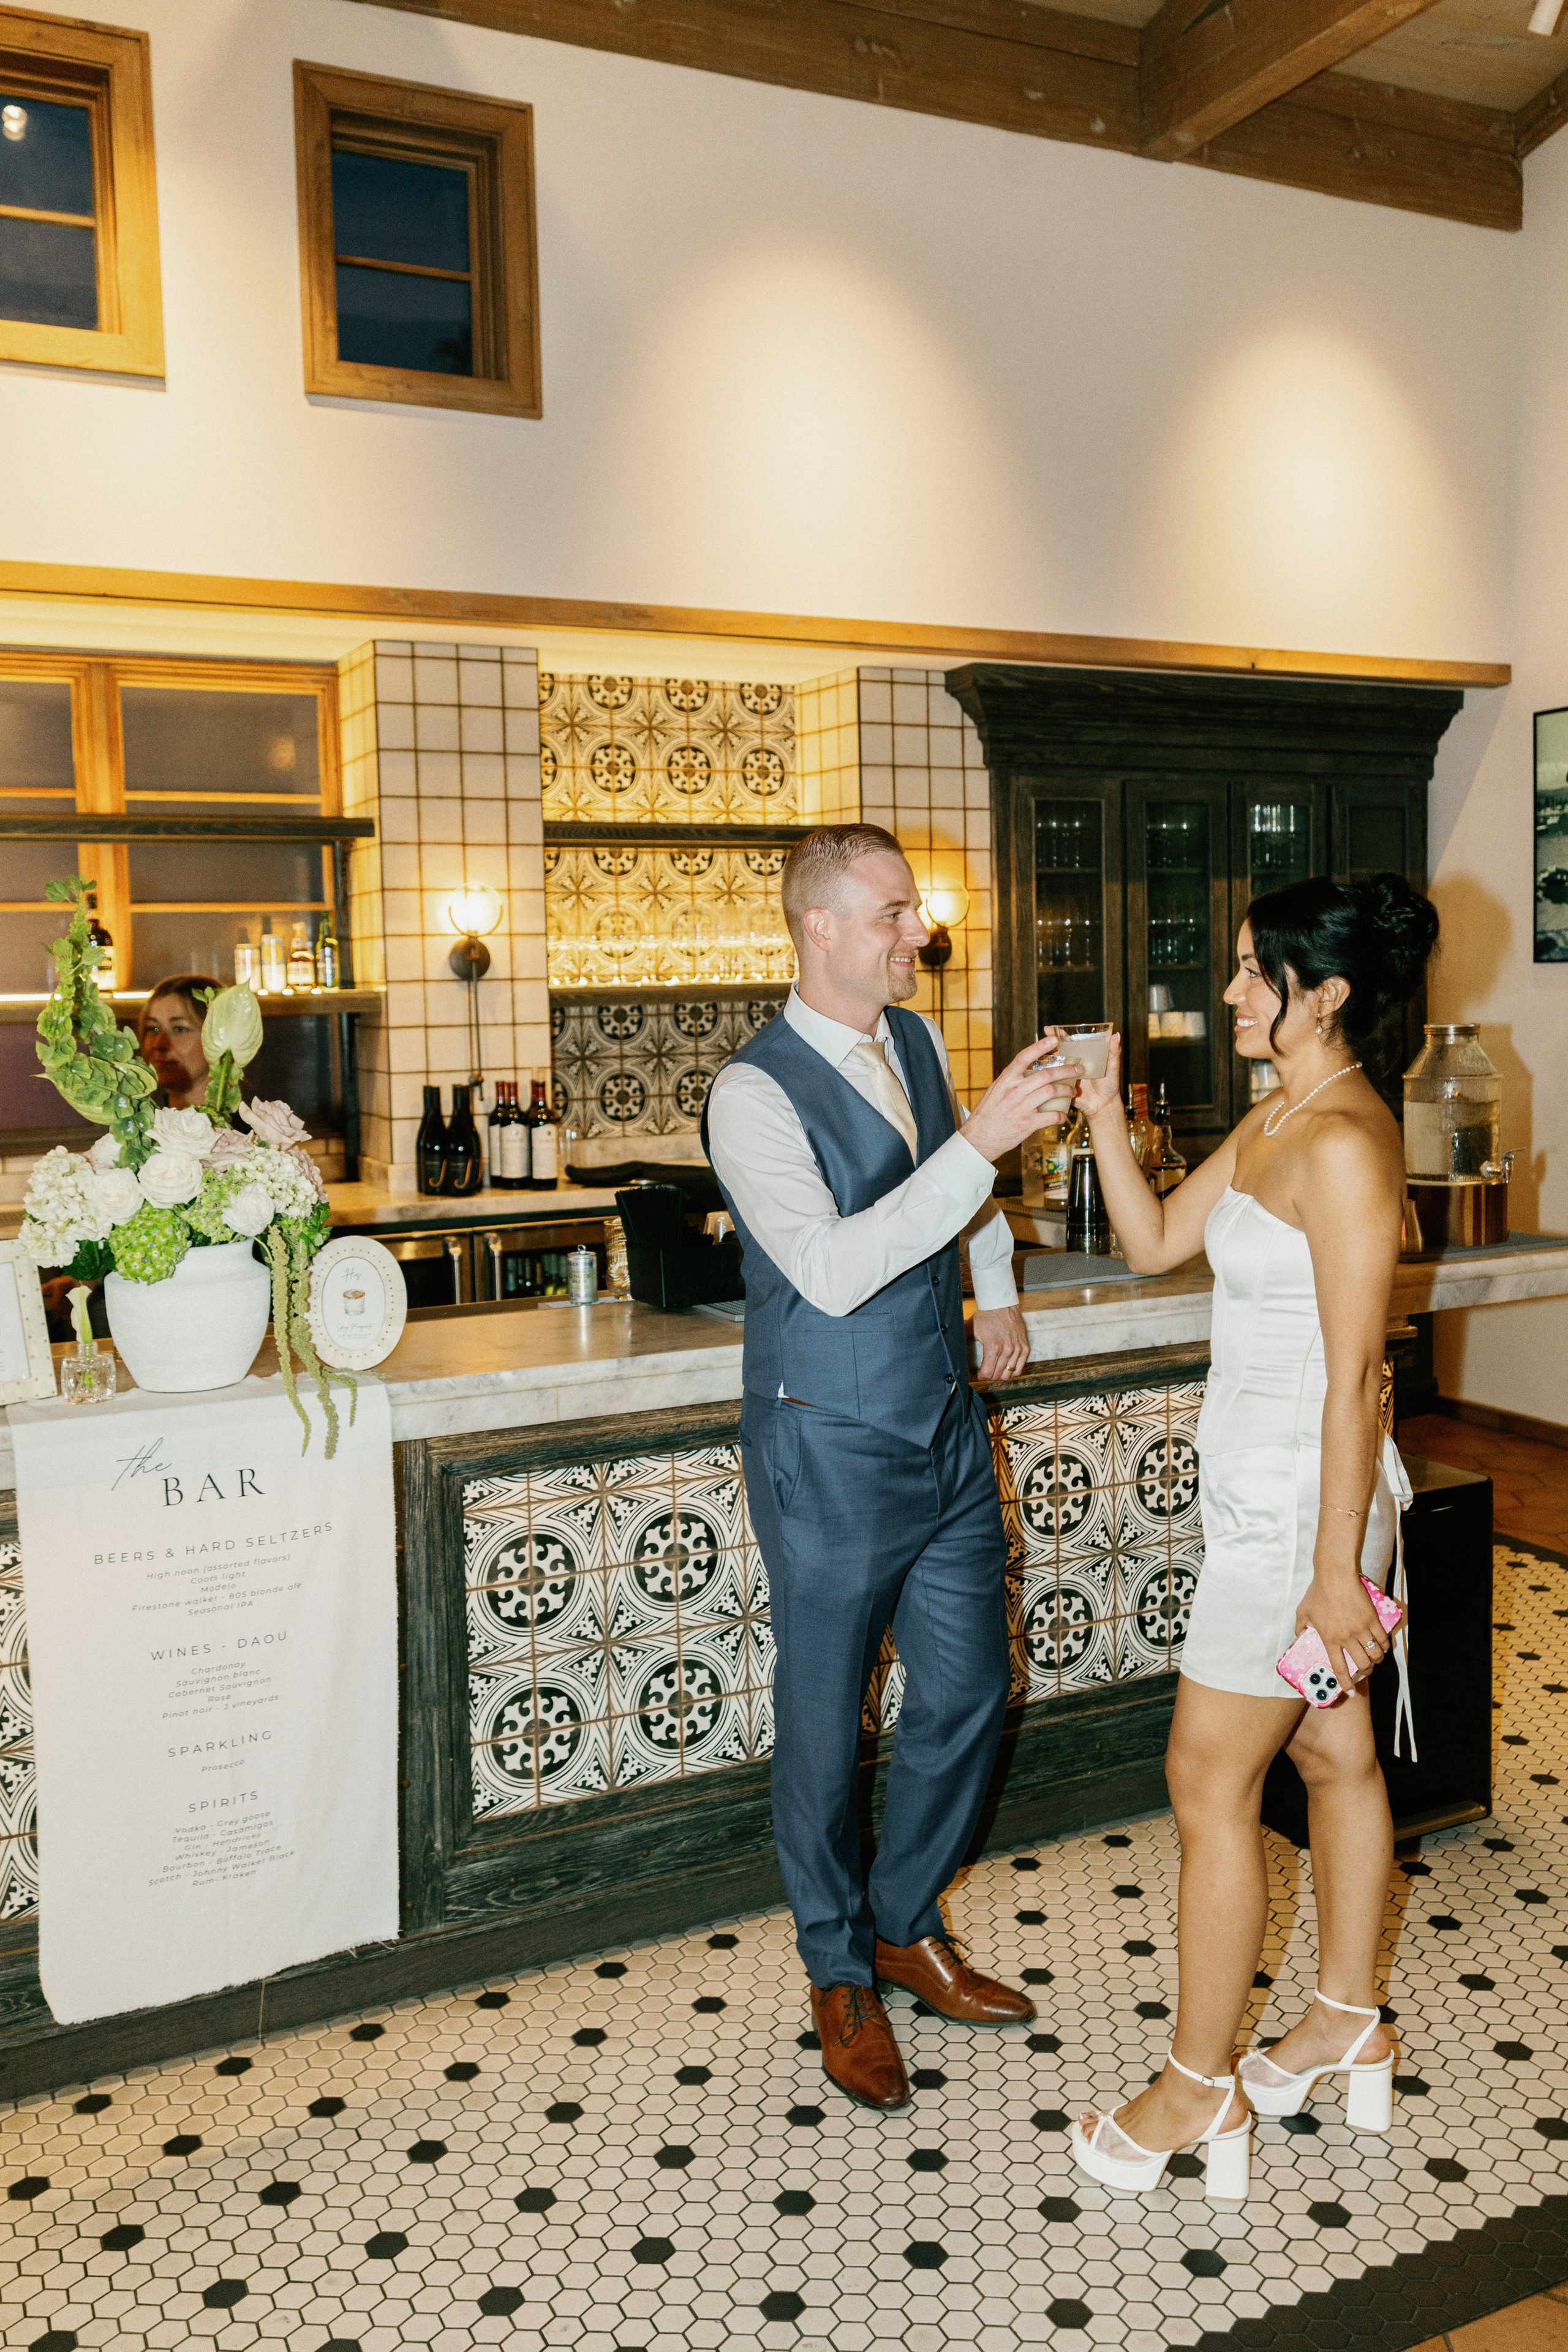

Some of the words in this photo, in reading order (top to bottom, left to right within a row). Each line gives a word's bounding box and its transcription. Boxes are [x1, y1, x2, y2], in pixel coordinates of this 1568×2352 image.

[111, 1437, 172, 1491] the
[161, 1468, 266, 1507] BAR
[94, 1550, 155, 1564] BEERS
[165, 1548, 175, 1558] &
[186, 1540, 236, 1555] HARD
[246, 1522, 333, 1547] SELTZERS
[146, 1570, 170, 1581] High
[175, 1567, 199, 1576] noon
[203, 1561, 249, 1574] (assorted
[253, 1553, 291, 1566] flavors)
[190, 1575, 218, 1584] Coors
[222, 1571, 246, 1583] light
[132, 1600, 180, 1611] Firestone
[184, 1594, 217, 1606] walker
[228, 1591, 247, 1600] 805
[251, 1585, 284, 1597] blonde
[287, 1582, 302, 1591] ale
[200, 1582, 236, 1593] Modelo
[187, 1603, 233, 1616] Seasonal
[236, 1600, 254, 1609] IPA
[151, 1644, 211, 1660] WINES
[238, 1631, 287, 1649] DAOU
[176, 1674, 230, 1687] Sauvignon
[233, 1669, 260, 1678] blanc
[191, 1661, 246, 1675] Chardonay
[168, 1686, 216, 1698] Cabernet
[219, 1677, 271, 1691] Sauvignon
[162, 1710, 189, 1719] Pinot
[192, 1706, 213, 1716] noir
[232, 1694, 279, 1709] vineyards
[168, 1730, 272, 1757] SPARKLING
[201, 1759, 245, 1773] Prosecco
[188, 1791, 258, 1813] SPIRITS
[173, 1833, 209, 1843] Tequila
[220, 1820, 274, 1836] Casamigos
[175, 1825, 206, 1833] Vodka
[217, 1818, 239, 1828] Grey
[242, 1811, 271, 1823] goose
[175, 1850, 217, 1861] Whiskey
[227, 1839, 270, 1852] Jameson
[213, 1832, 262, 1847] Hendricks
[148, 1874, 181, 1887] Scotch
[192, 1866, 228, 1877] Johnny
[232, 1858, 265, 1869] Walker
[269, 1850, 295, 1861] Black
[163, 1861, 205, 1872] Bourbon
[216, 1852, 252, 1864] Buffalo
[256, 1845, 281, 1856] Trace
[222, 1869, 257, 1880] Kraken
